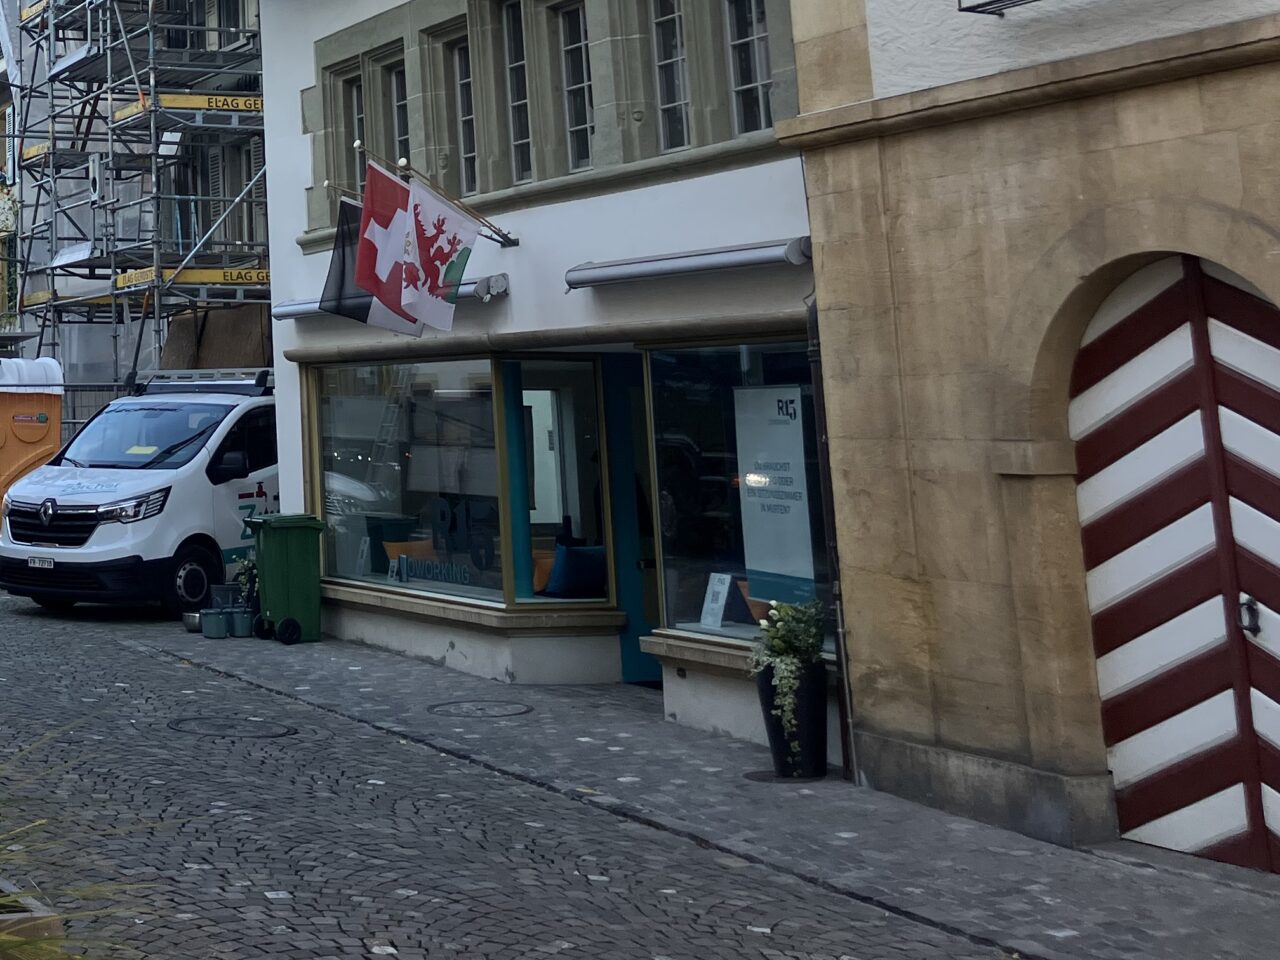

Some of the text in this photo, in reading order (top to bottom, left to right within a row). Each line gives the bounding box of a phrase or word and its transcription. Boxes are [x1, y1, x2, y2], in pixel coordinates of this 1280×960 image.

[207, 97, 240, 109] ELAG
[222, 271, 253, 282] ELAG
[776, 398, 797, 421] R15
[402, 559, 470, 584] OWORKING
